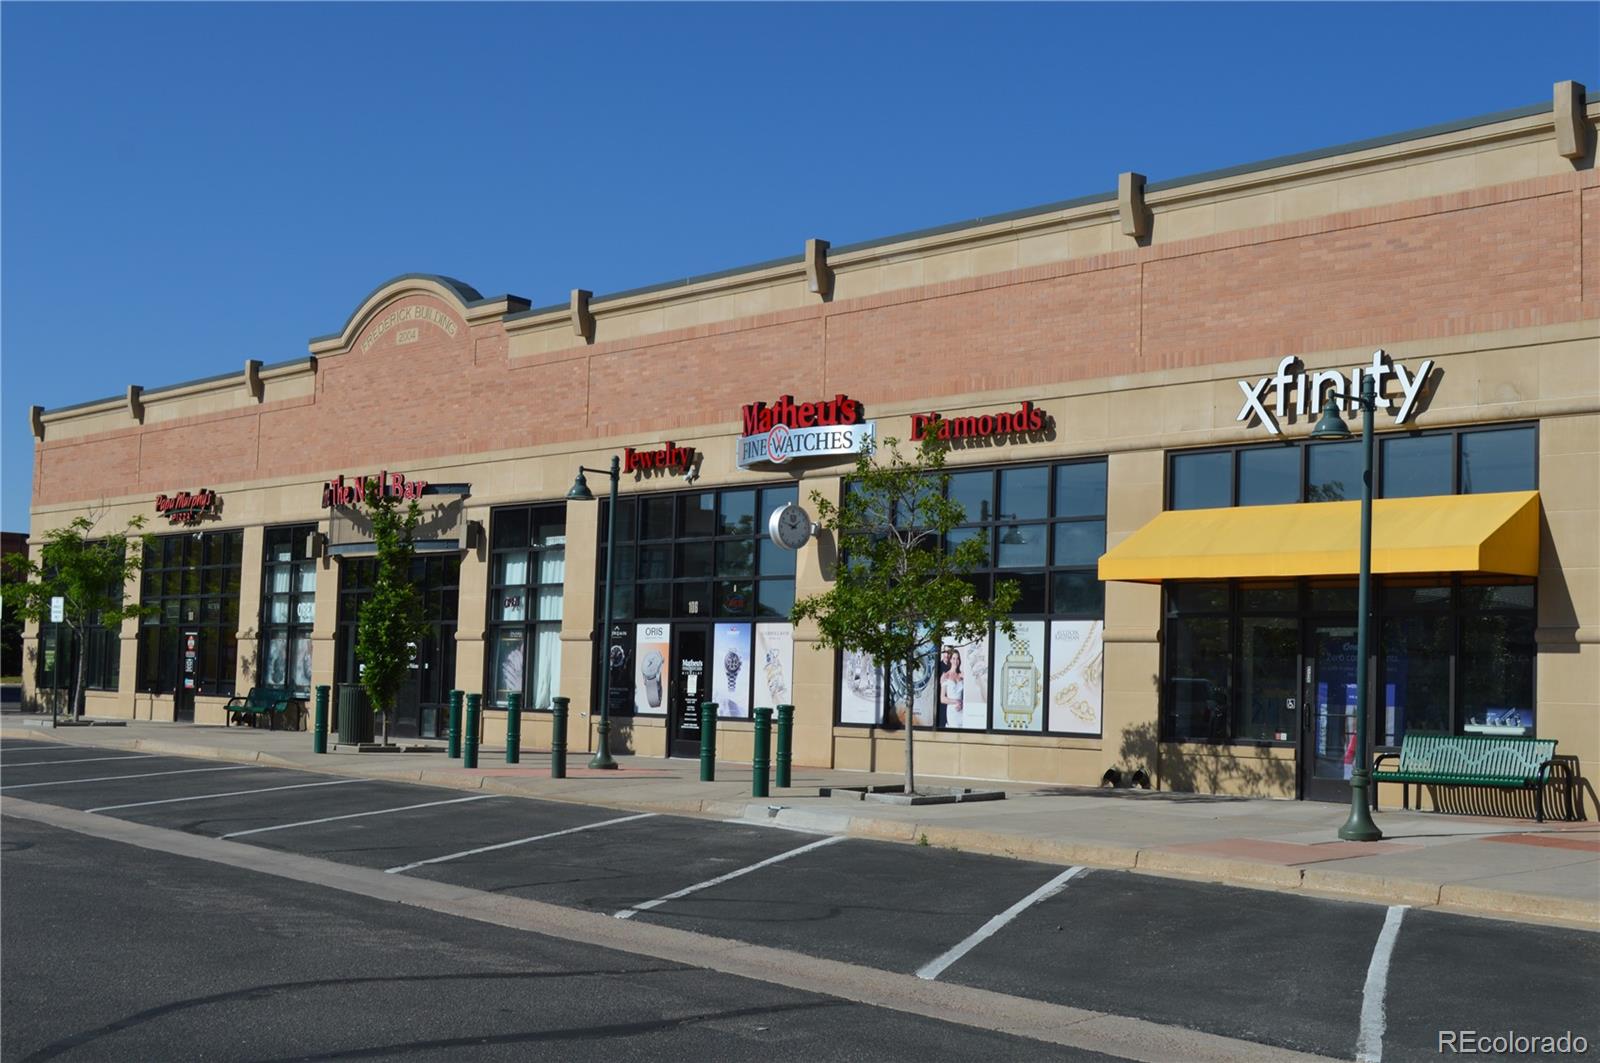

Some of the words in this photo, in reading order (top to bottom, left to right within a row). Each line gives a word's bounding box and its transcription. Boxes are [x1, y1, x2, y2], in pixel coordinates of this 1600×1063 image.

[362, 307, 412, 350] FREDERICK
[415, 306, 456, 335] BUILDING
[399, 330, 417, 342] 2004
[1236, 349, 1434, 435] xfinity
[742, 394, 860, 437] Matheu's
[623, 441, 694, 475] Jewelry
[743, 437, 767, 461] FINE
[769, 430, 853, 453] WATCHES
[330, 477, 350, 506] The
[354, 470, 387, 503] Nl
[392, 471, 427, 500] Bar
[645, 627, 663, 637] ORIS
